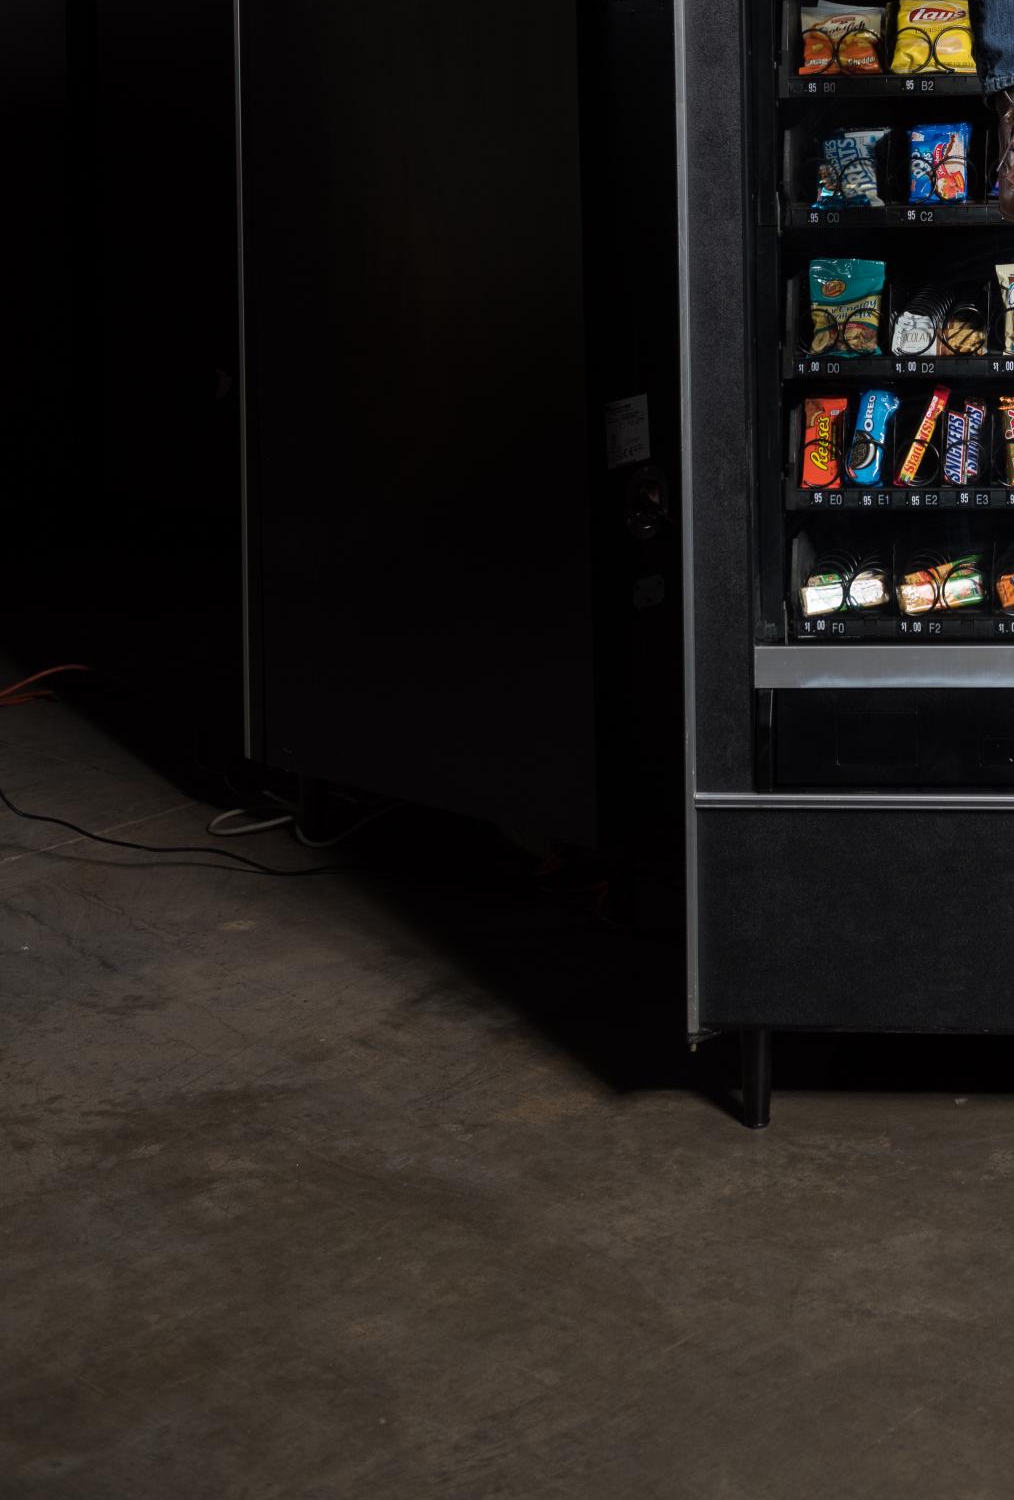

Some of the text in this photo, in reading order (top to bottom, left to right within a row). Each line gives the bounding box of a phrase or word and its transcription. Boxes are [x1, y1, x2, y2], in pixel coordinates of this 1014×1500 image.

[805, 82, 837, 93] .95 B0
[903, 79, 935, 91] .95 B2
[808, 211, 840, 223] .95 C0
[902, 210, 934, 222] .95 C2
[799, 362, 840, 374] $1.00 D0
[896, 361, 935, 374] $1.00 D2
[993, 361, 1014, 373] $1.00
[865, 395, 877, 432] OREO
[810, 415, 831, 470] Reese's
[904, 418, 937, 475] Starurst
[946, 414, 967, 485] SNICKERS
[812, 493, 843, 506] .95 E0
[859, 495, 890, 506] .95 E1
[906, 495, 939, 507] .95 E2
[957, 492, 989, 505] .95 E3
[805, 619, 846, 634] $1.00 F0
[901, 621, 942, 634] $1.00 F2
